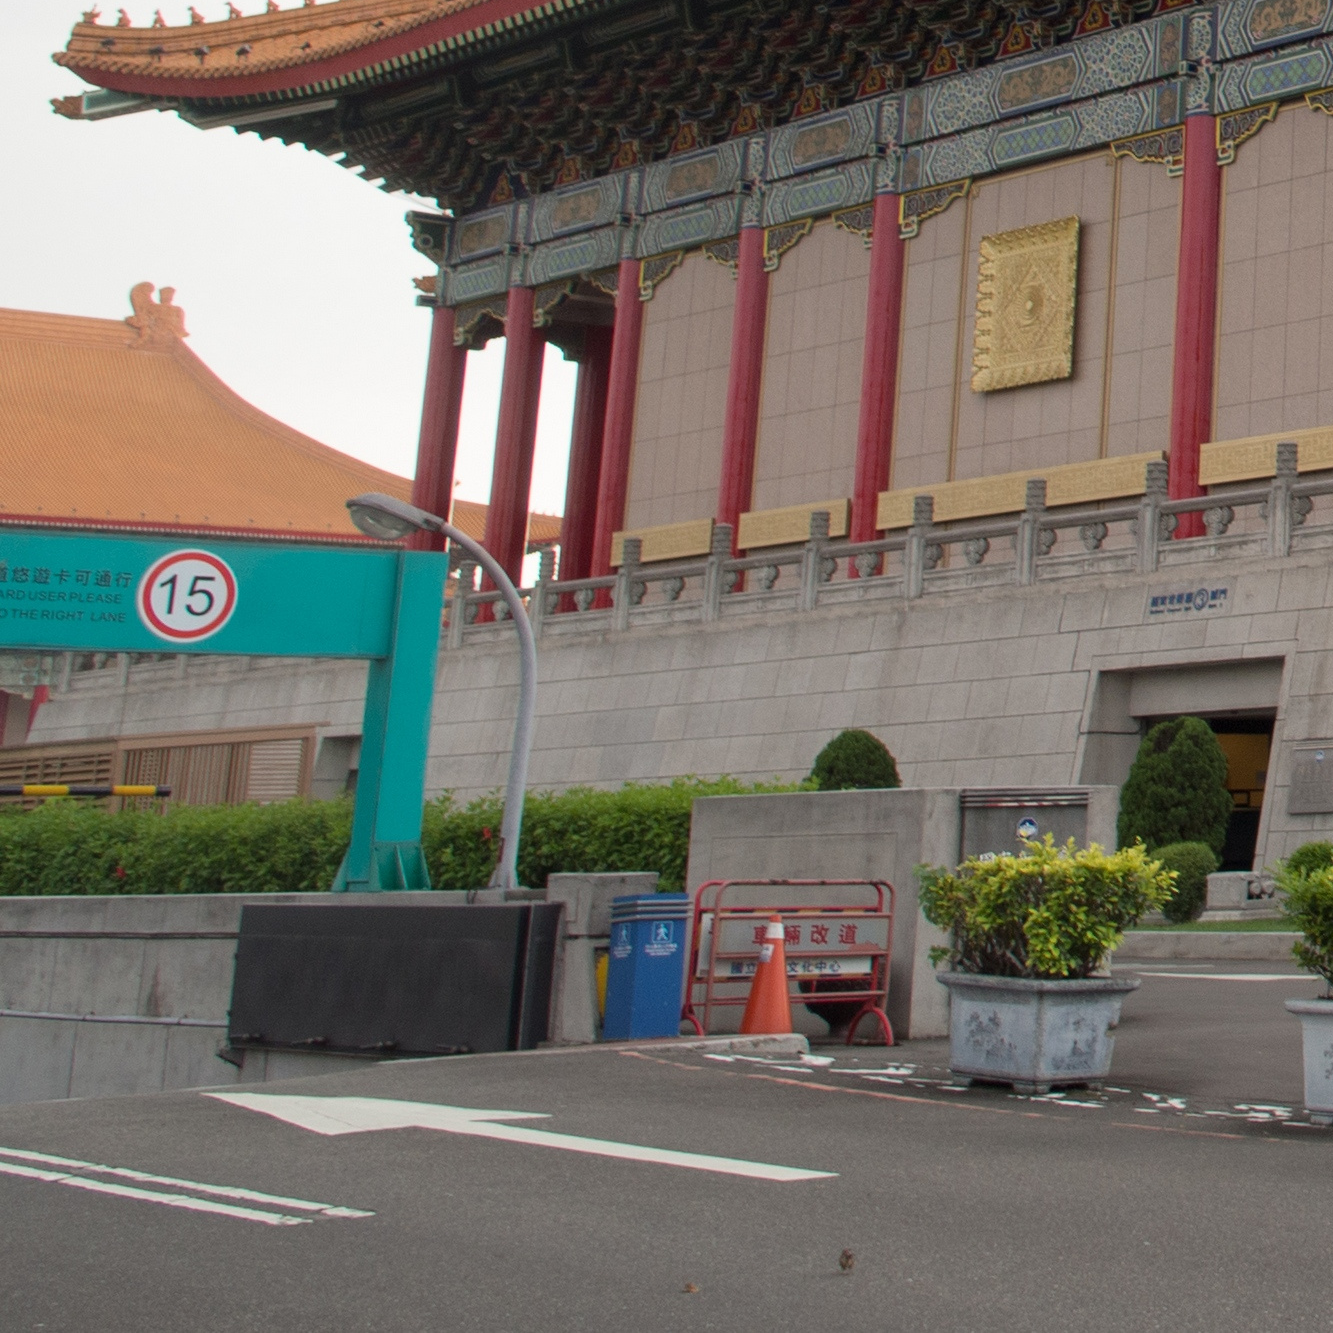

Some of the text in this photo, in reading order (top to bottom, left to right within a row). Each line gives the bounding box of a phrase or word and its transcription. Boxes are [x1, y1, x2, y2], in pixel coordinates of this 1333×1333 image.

[28, 590, 67, 602] USER
[69, 592, 122, 604] PLEASE
[160, 574, 216, 617] 15
[12, 609, 38, 620] THE
[41, 610, 84, 621] RIGHT
[90, 612, 127, 623] LANE
[731, 960, 842, 974] 國立文化中心
